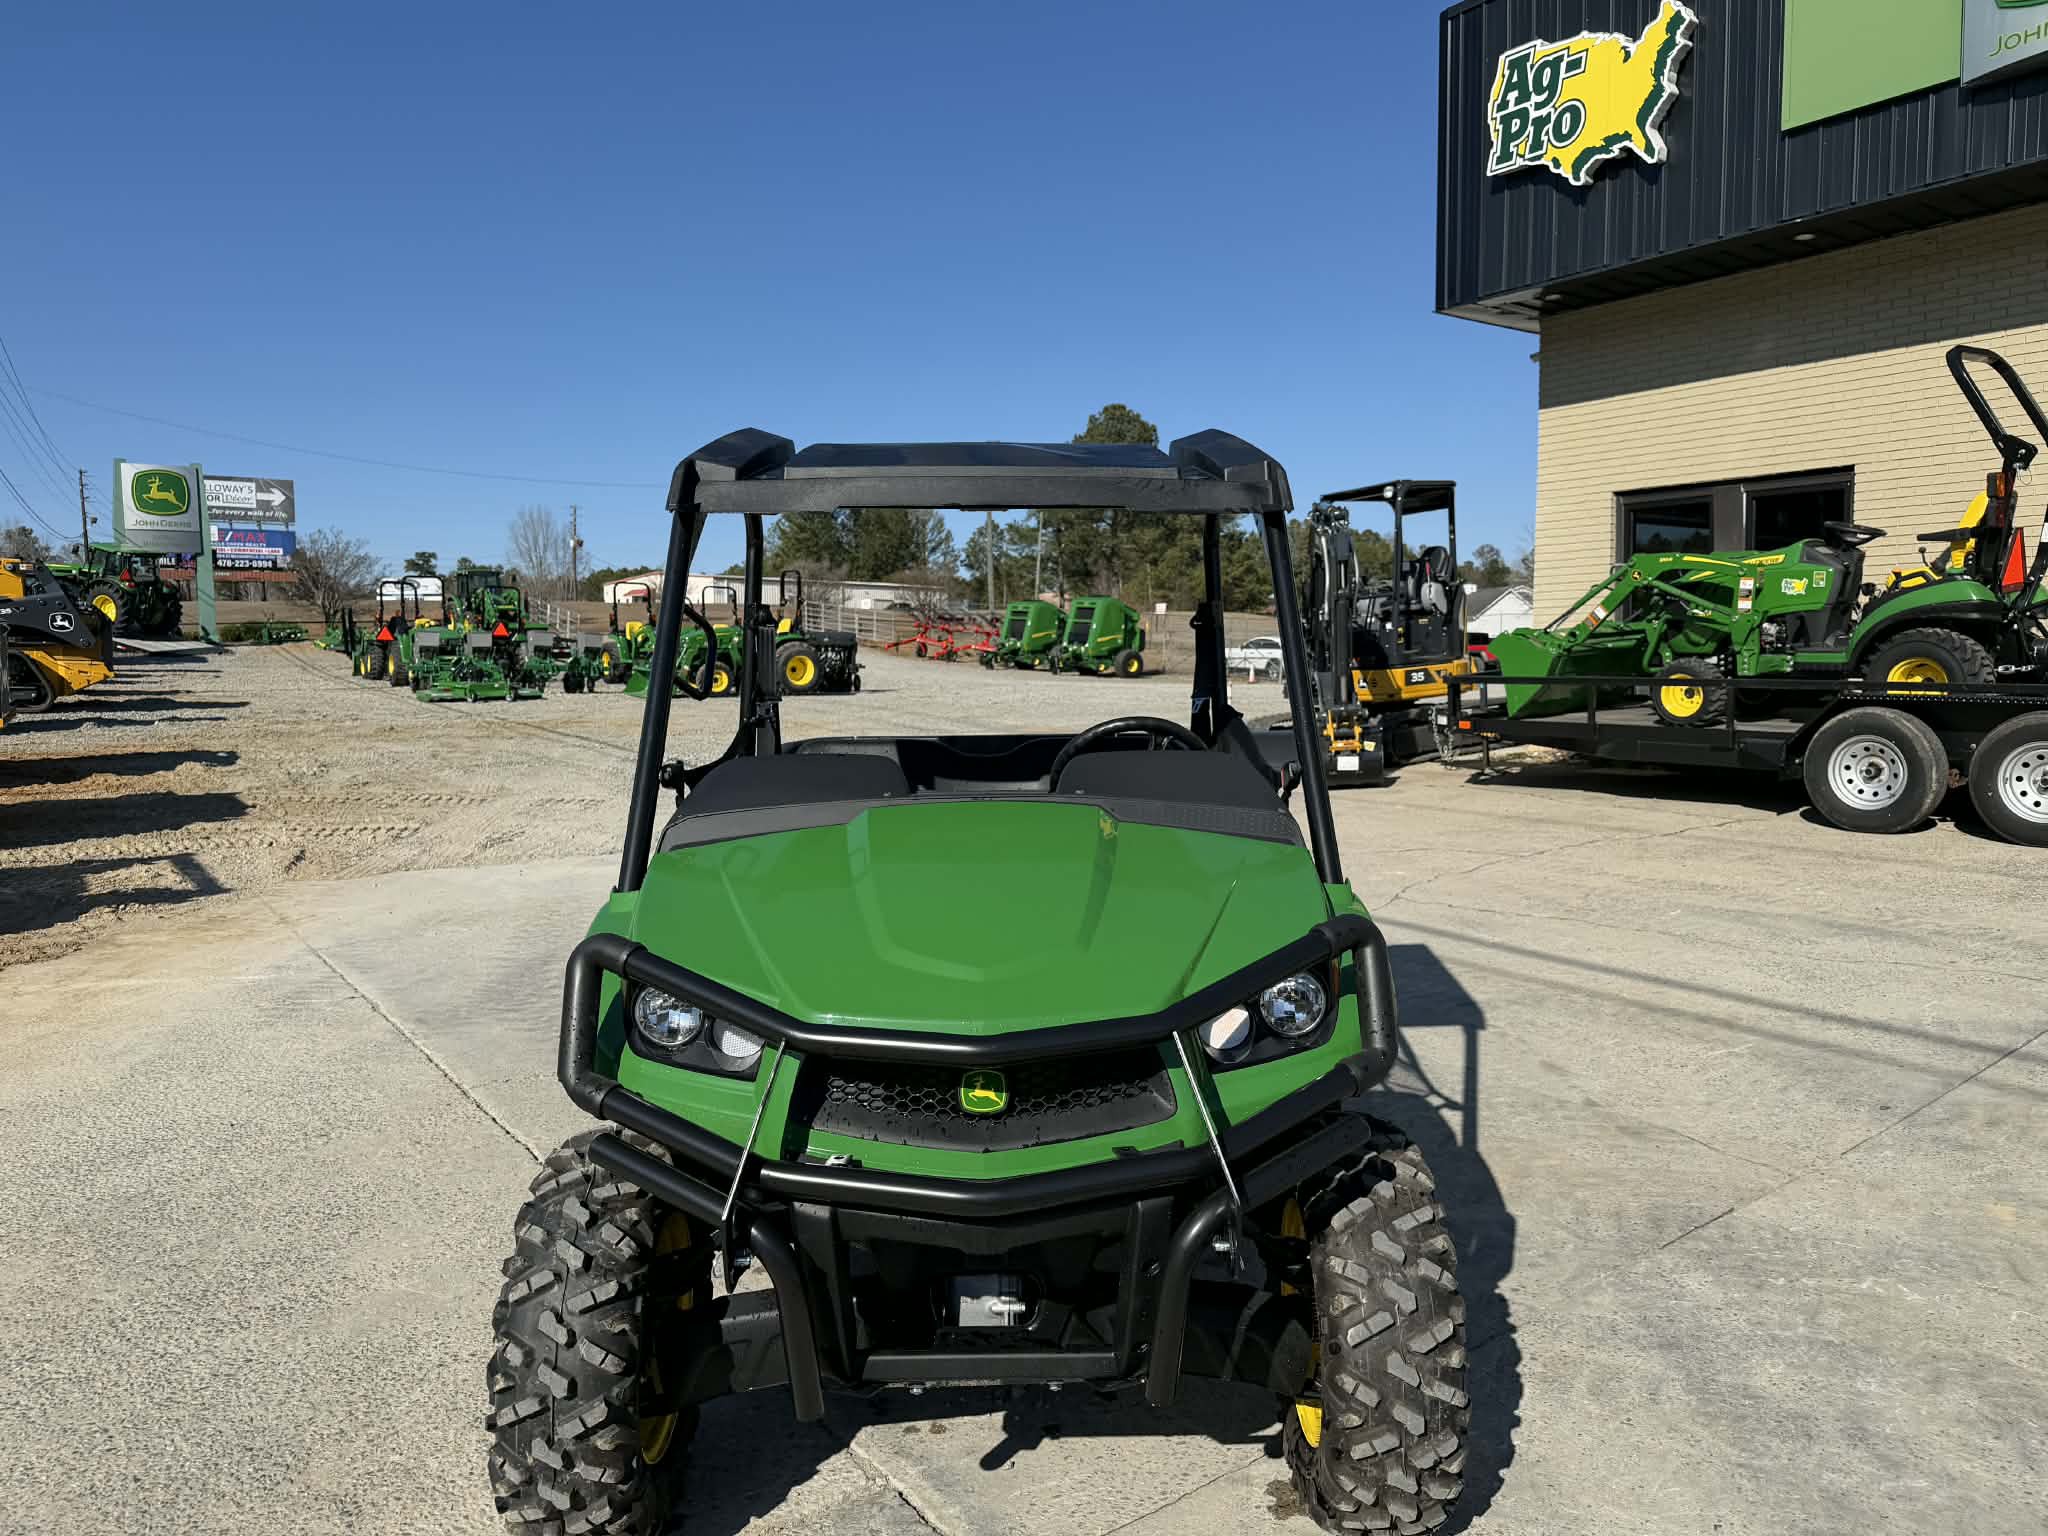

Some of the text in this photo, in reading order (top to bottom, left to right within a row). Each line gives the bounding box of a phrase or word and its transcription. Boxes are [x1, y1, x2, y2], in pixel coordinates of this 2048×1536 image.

[1494, 49, 1586, 113] Ag-
[1494, 102, 1584, 166] Pro
[204, 483, 254, 494] LOWAY'S
[131, 519, 159, 527] JOHN
[1410, 671, 1425, 682] 35
